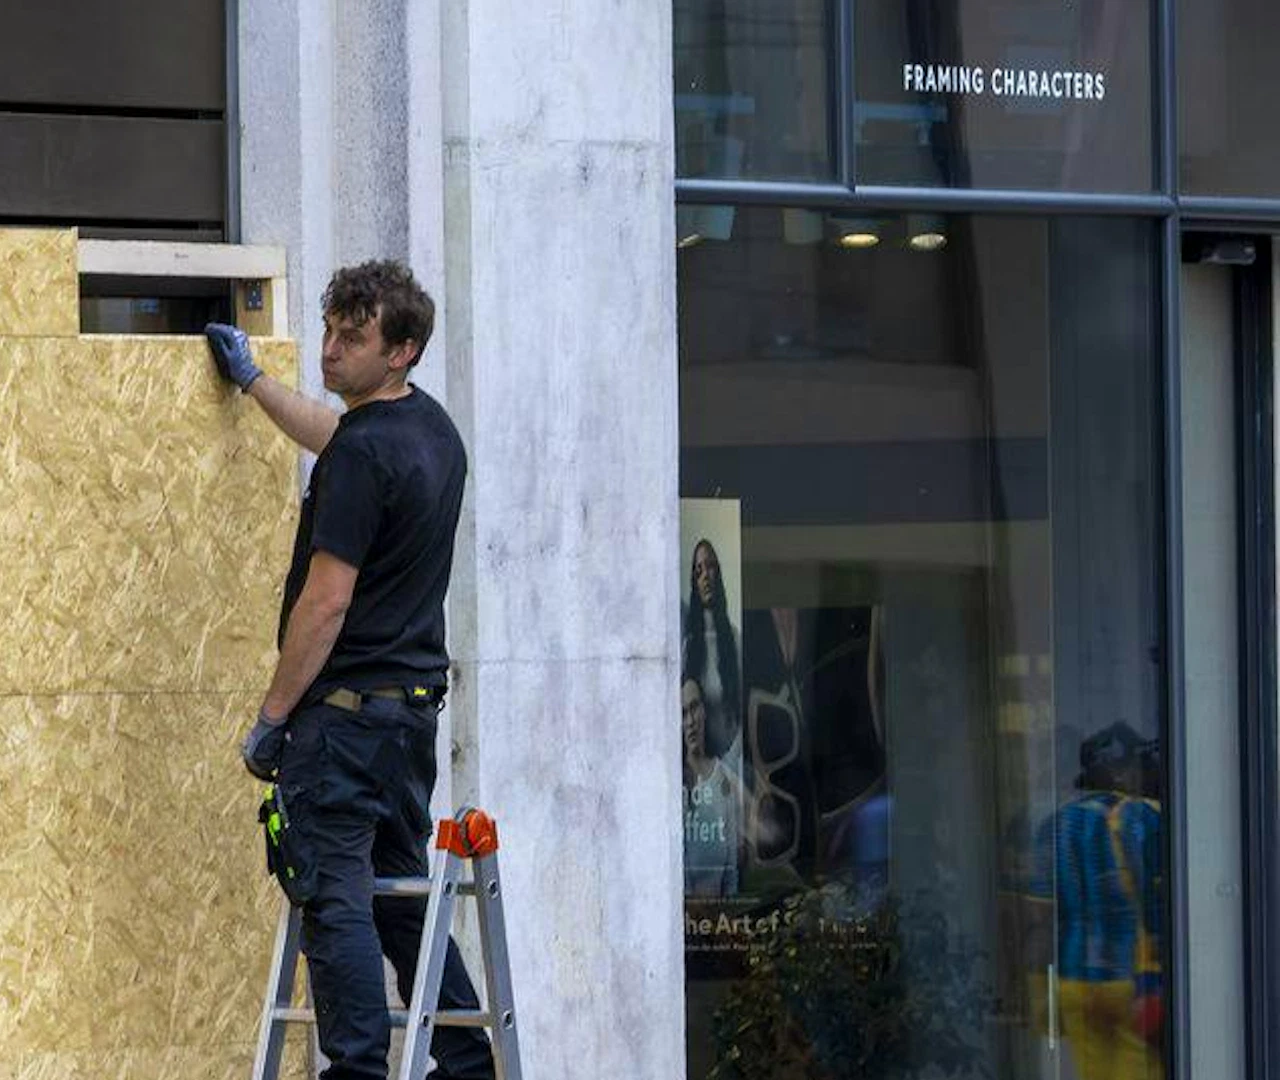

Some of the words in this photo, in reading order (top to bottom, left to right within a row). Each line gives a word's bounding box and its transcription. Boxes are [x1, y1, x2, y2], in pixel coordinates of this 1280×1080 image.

[903, 63, 985, 95] FRAMING
[991, 69, 1106, 101] CHARACTERS
[691, 774, 713, 806] de
[715, 912, 751, 935] Art
